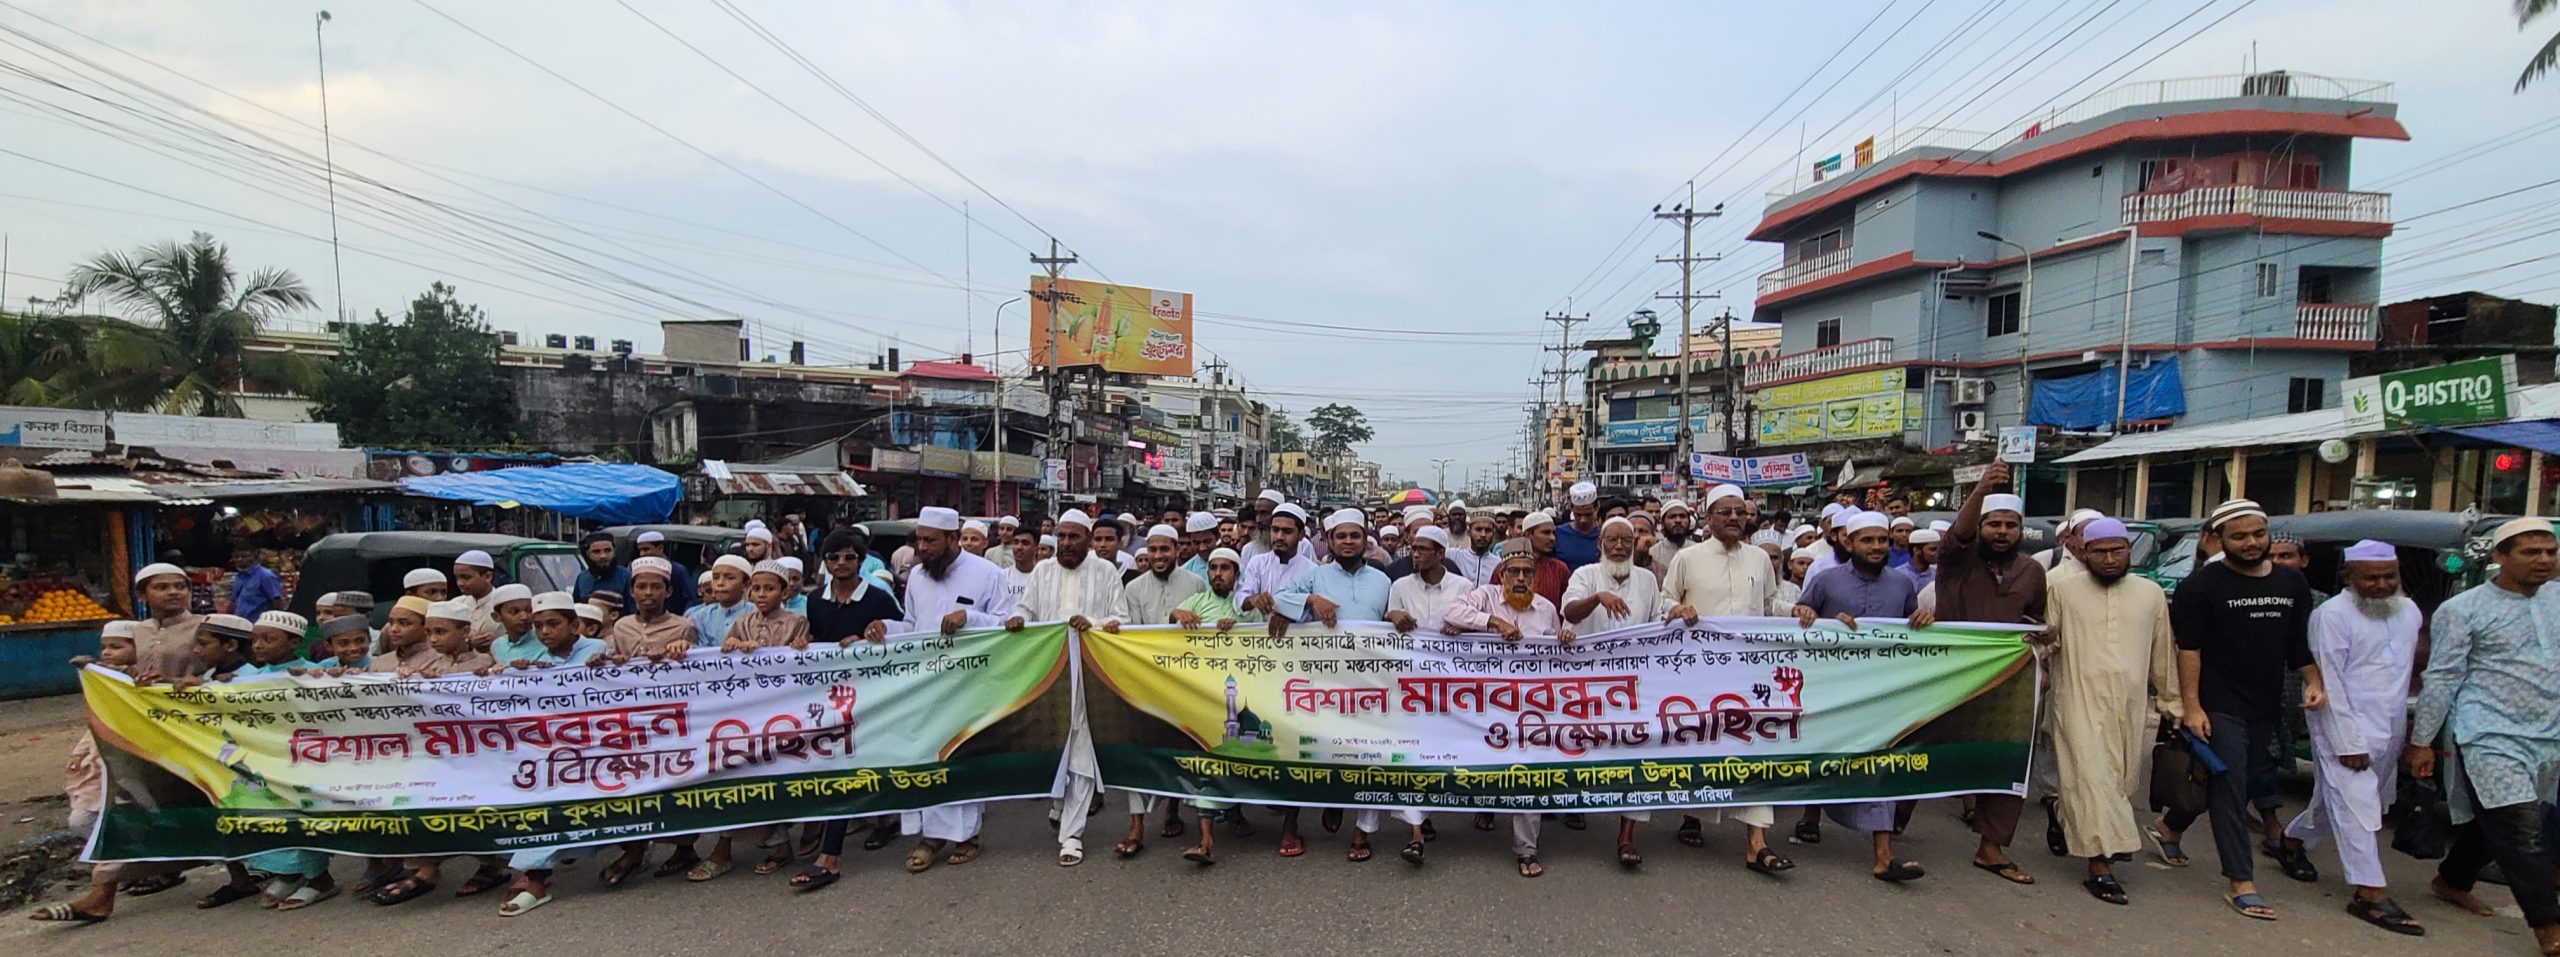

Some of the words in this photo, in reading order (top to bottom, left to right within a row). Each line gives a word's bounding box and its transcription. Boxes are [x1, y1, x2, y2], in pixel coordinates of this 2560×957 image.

[2384, 374, 2493, 417] Q-BISTRO
[23, 420, 60, 432] কনক
[2226, 598, 2257, 608] THOM
[2258, 596, 2294, 607] BROWE
[1152, 651, 1201, 670] আপত্তি
[1204, 656, 1229, 671] কর
[1282, 659, 1295, 673] ও
[1300, 659, 1341, 674] জঘন্য
[1345, 658, 1413, 674] মন্তব্যকরণ
[1419, 658, 1450, 674] এবং
[1452, 656, 1503, 674] বিজেপি
[1508, 658, 1542, 674] নেতা
[1549, 656, 1596, 674] নিতেশ
[1600, 654, 1650, 671] নারায়ণ
[1654, 648, 1698, 674] কর্তৃক
[1702, 648, 1732, 665] উক্ত
[1738, 648, 1799, 666] মন্তব্যকে
[1805, 644, 1871, 662] সমর্থনের
[1184, 632, 1234, 649] সম্প্রতি
[1237, 635, 1295, 650] ভারতের
[1420, 639, 1474, 654] মহারাজ
[281, 711, 297, 724] ও
[430, 704, 467, 718] এবং
[470, 695, 532, 717] বিজেপি
[537, 693, 577, 710] নেতা
[582, 686, 639, 708] নিতেশ
[644, 681, 700, 700] নারায়ণ
[705, 673, 751, 699] কর্তৃক
[754, 672, 787, 689] উক্ত
[791, 667, 853, 687] মন্তব্যকে
[857, 659, 920, 680] সমর্থনের
[925, 653, 992, 674] প্রতিবাদে
[1282, 677, 1391, 715] বিশাল
[1397, 674, 1640, 720] মানববন্ধন
[288, 728, 410, 768] বিশাল
[413, 700, 689, 757] মানববন্ধন
[1484, 721, 1510, 750] ও
[1515, 709, 1650, 756] বিক্ষোভ
[1655, 693, 1804, 745] মিছিল
[512, 758, 537, 790] ও
[546, 746, 698, 792] বিক্ষোভ
[705, 714, 858, 776] মিছিল
[1173, 755, 1281, 782] আয়োজনে:
[1287, 765, 1331, 785] আল
[1340, 764, 1448, 792] জামিয়াতুল
[1453, 766, 1567, 790] ইসলামিয়াহ
[1575, 765, 1636, 788] দারুল
[418, 805, 551, 833] তাহসিনুল
[562, 793, 663, 830] কুরআন
[783, 769, 882, 798] রণকেলী
[888, 767, 950, 791] উত্তর
[1397, 792, 1425, 804] আত
[1500, 794, 1535, 807] সংসদ
[1538, 795, 1550, 806] ও
[1552, 793, 1578, 807] আল
[1581, 789, 1624, 807] ইকবাল
[1666, 789, 1690, 804] ছাত্র
[1693, 785, 1734, 803] পরিষদ
